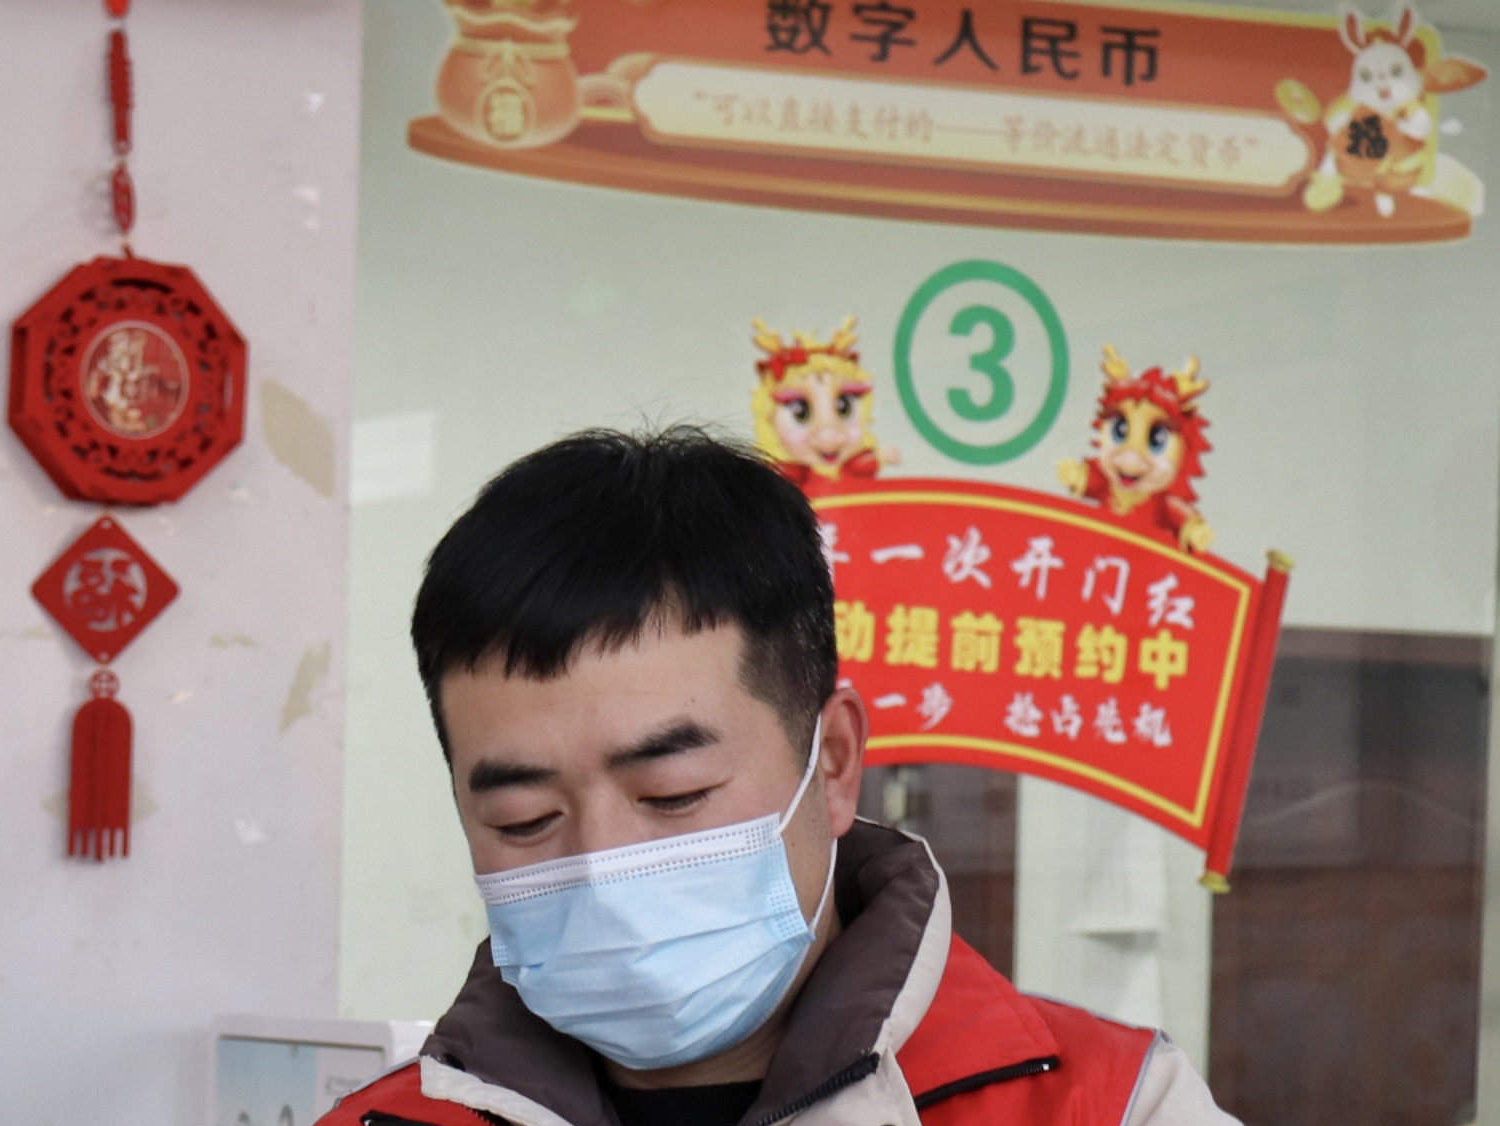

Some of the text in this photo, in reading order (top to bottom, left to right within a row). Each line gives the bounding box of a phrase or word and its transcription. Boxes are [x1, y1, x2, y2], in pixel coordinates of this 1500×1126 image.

[764, 0, 1162, 87] 数字人民币
[947, 304, 1016, 423] 3
[837, 678, 1172, 748] 一步 抢占先机
